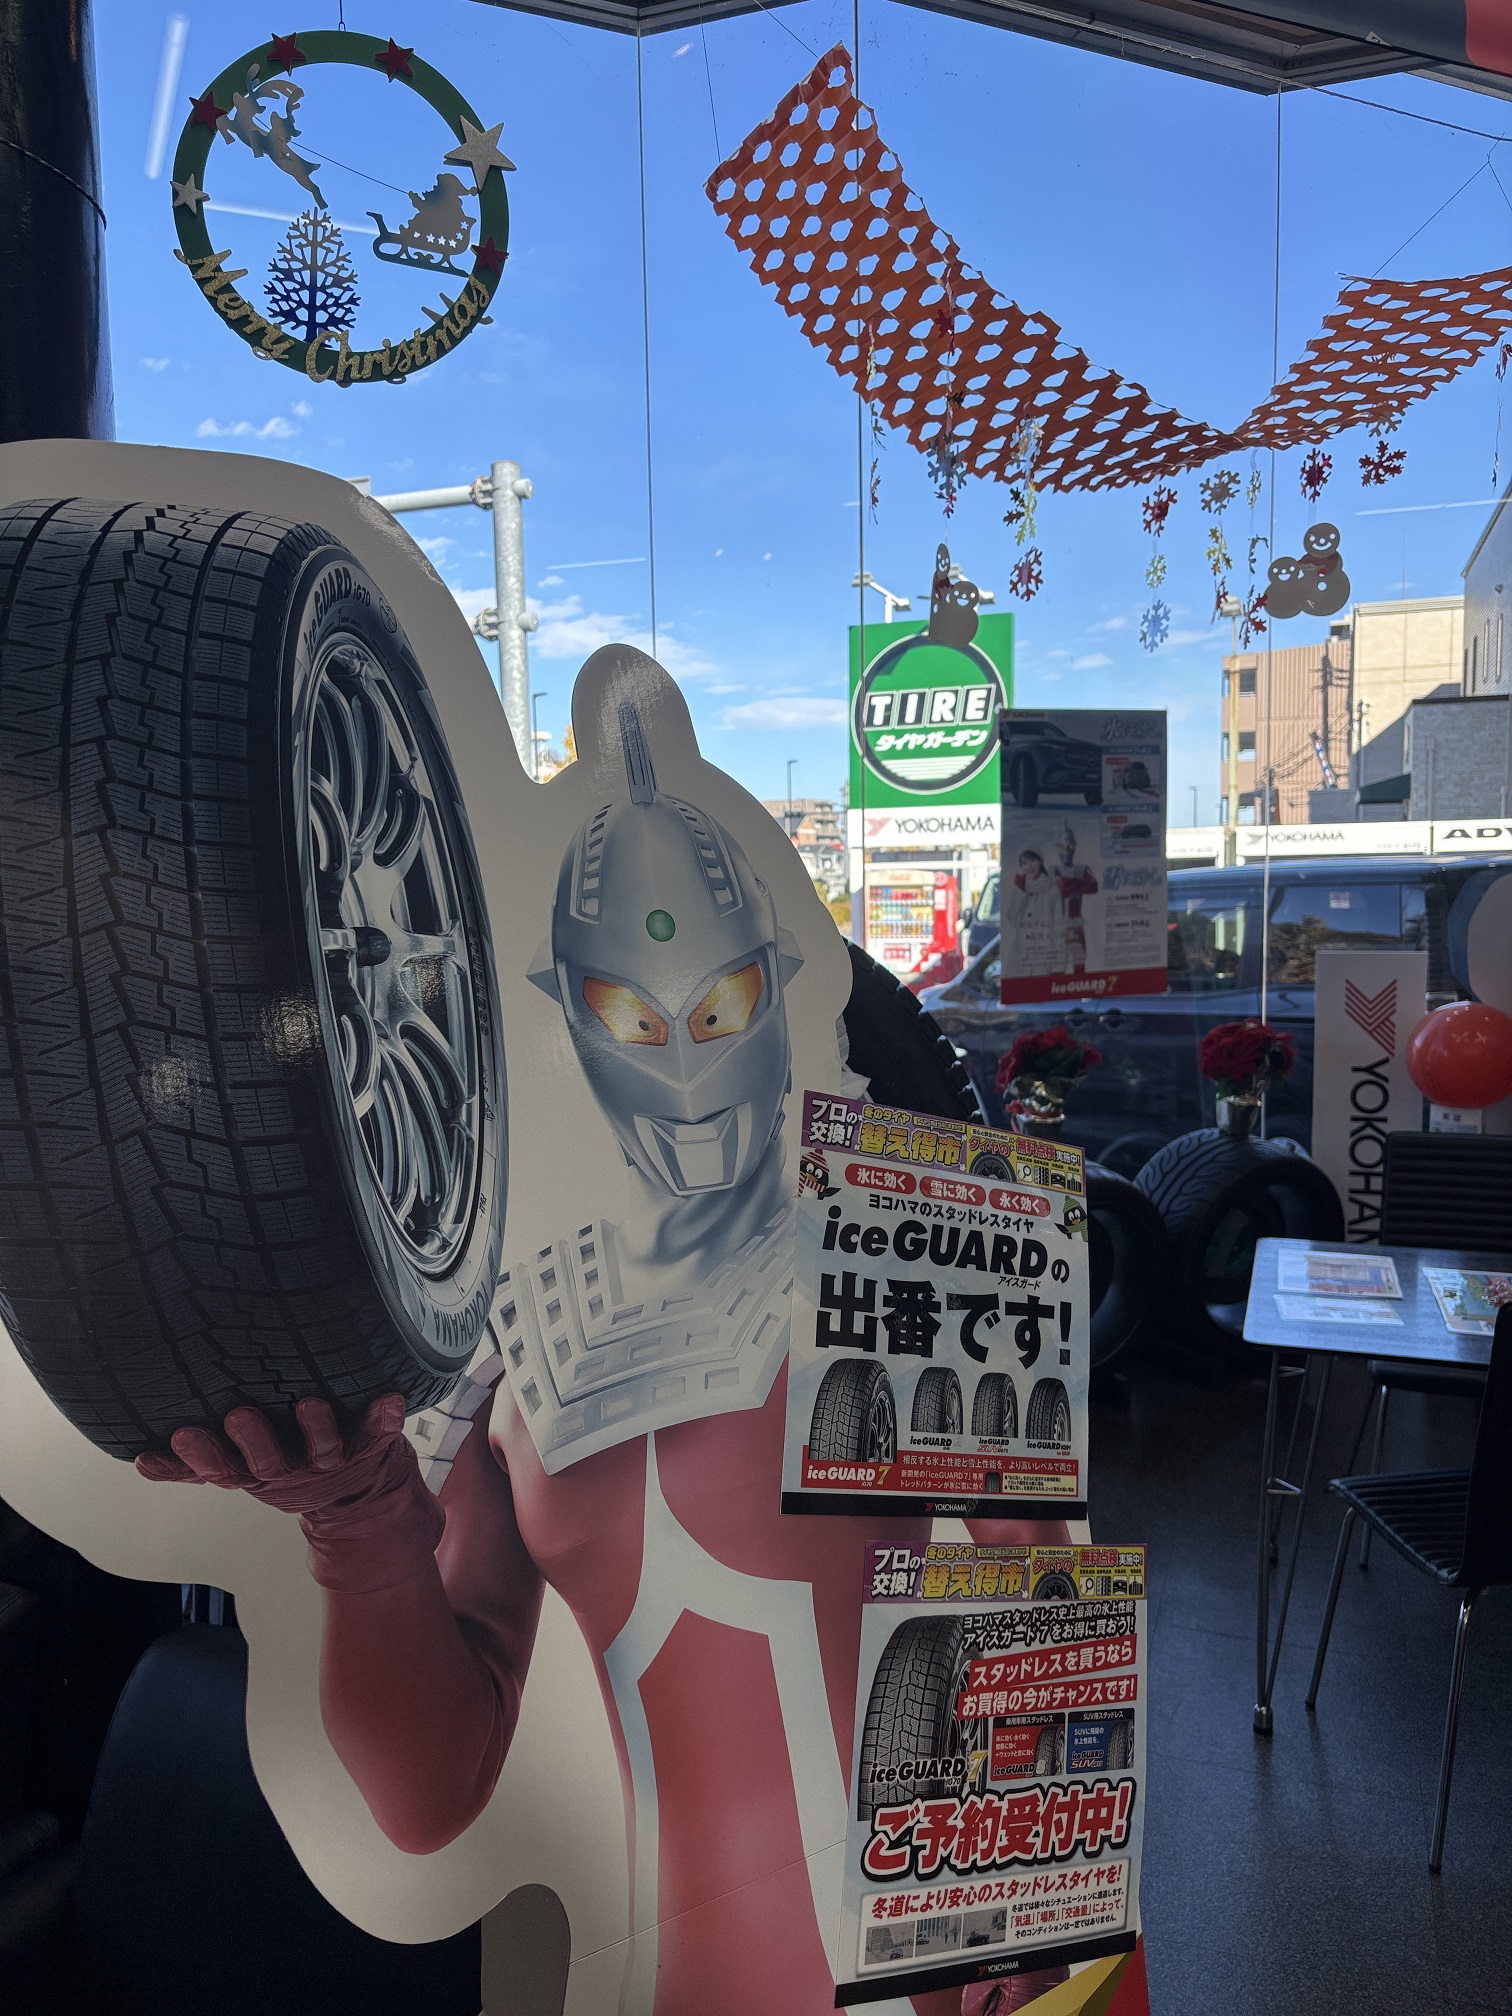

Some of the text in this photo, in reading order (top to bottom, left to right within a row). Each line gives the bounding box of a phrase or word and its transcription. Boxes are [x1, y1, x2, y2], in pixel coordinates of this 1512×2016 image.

[174, 248, 494, 388] Merry Christmas
[868, 686, 988, 727] TIRE
[874, 729, 988, 752] タイヤガーデン
[894, 815, 995, 835] YOKOHAMA
[1268, 829, 1346, 845] YOKOHAMA
[1051, 973, 1119, 995] iceGUARD 7
[810, 1098, 857, 1125] プロの
[863, 1103, 912, 1124] 冬のタイヤ
[809, 1120, 854, 1149] 交換!
[859, 1122, 963, 1167] 替え得市
[969, 1135, 1010, 1157] タイヤの
[856, 1167, 1041, 1214] 氷に効く 雪に効く 永く効く
[868, 1194, 1034, 1233] ヨコハマのスタッドレスタイヤ
[997, 1275, 1042, 1290] アイスガード
[430, 1281, 491, 1348] YOKOHAMA
[815, 1271, 1072, 1370] 出番です!
[909, 1435, 953, 1447] iceGUARD
[978, 1437, 1010, 1446] iceGUARD
[1026, 1439, 1061, 1450] iceGUARD
[806, 1464, 893, 1486] iceGUARD 7
[902, 1455, 1077, 1474] 相反する氷上性能と雪上性能を、より高いレベルで両立!
[899, 1479, 984, 1491] トレッドパターンが氷に雪に効く
[934, 1503, 967, 1513] YOKOHAMA
[872, 1546, 921, 1572] プロの
[926, 1544, 975, 1559] 冬のタイヤ
[1033, 1557, 1074, 1574] タイヤの
[871, 1572, 916, 1598] 交換!
[921, 1562, 1024, 1599] 替え得市
[963, 1600, 1134, 1629] ヨコハマスタッドレス史上最高の氷上性能
[963, 1616, 1136, 1650] アイスガード7をお得に買おう!
[972, 1641, 1133, 1688] スタッドレスを買うなら
[962, 1679, 1135, 1717] お買得の今がチャンスです!
[1083, 1711, 1124, 1721] SUV用スタッドレス
[869, 1749, 989, 1784] iceGUARD 7
[1070, 1759, 1093, 1769] SUV
[1072, 1749, 1104, 1760] iceGUARD
[993, 1763, 1035, 1776] iceGUARD
[866, 1784, 1131, 1872] ご予約受付中!
[871, 1865, 1122, 1919] 冬道により安心のスタッドレスタイヤを!
[1010, 1898, 1124, 1929] 「気温」「場所」「交通量」によって、
[1014, 1913, 1117, 1939] そのコンディションは一定ではありません。
[987, 1960, 1020, 1973] YOKOHAMA
